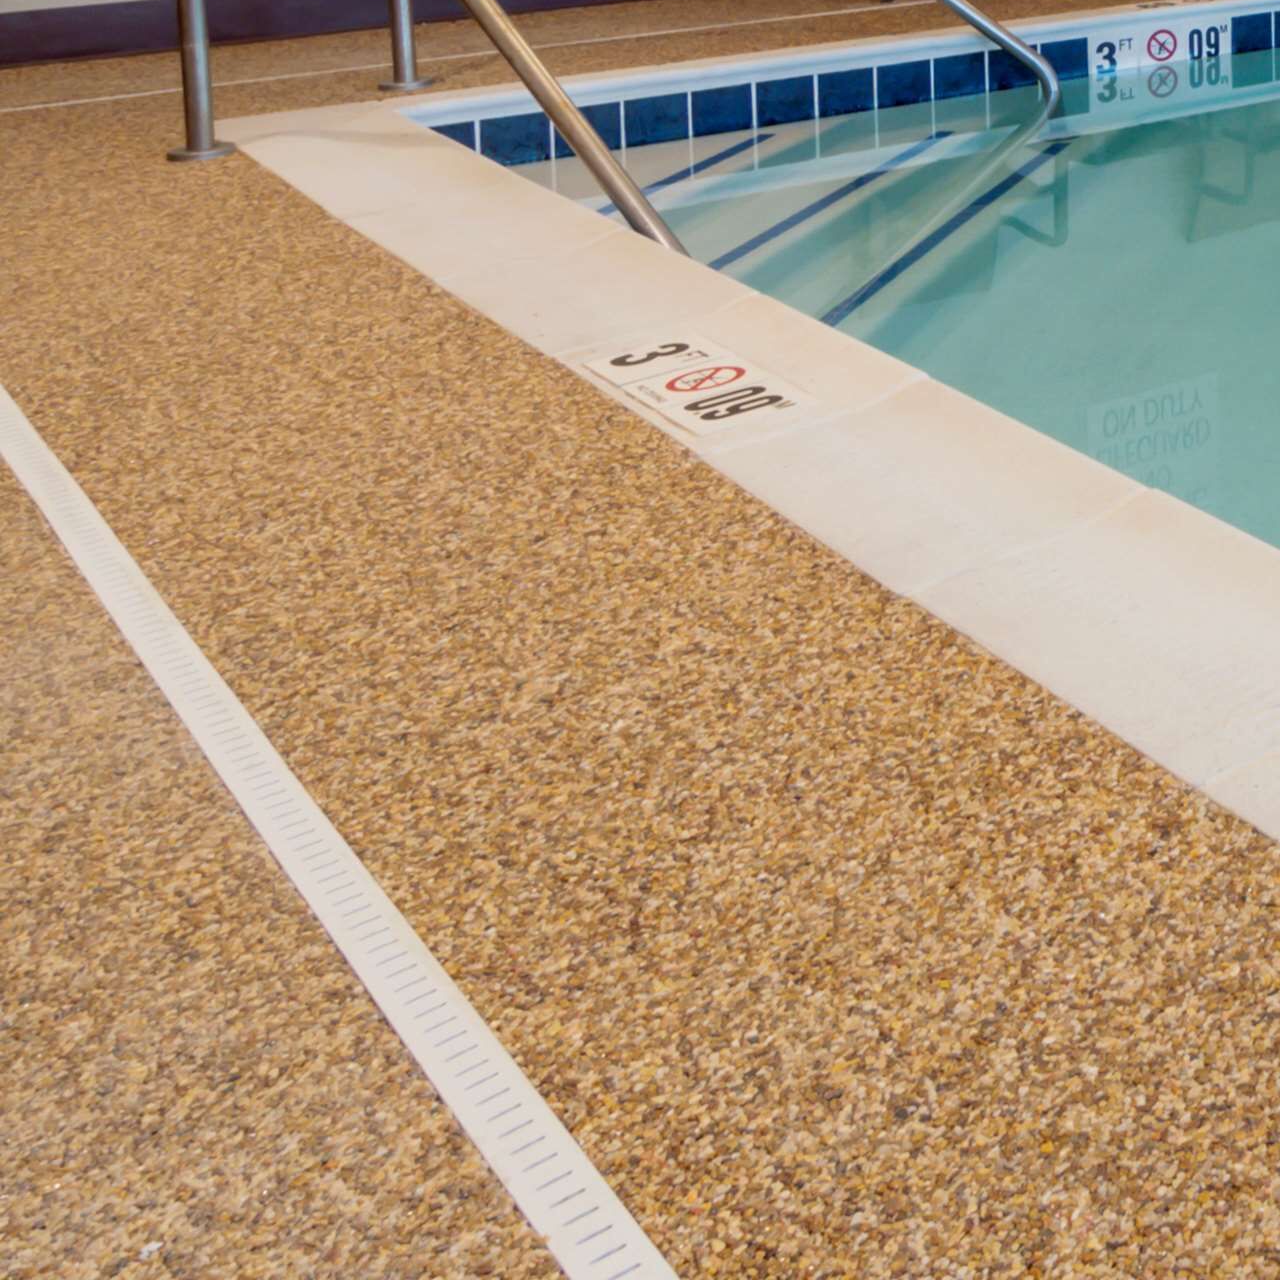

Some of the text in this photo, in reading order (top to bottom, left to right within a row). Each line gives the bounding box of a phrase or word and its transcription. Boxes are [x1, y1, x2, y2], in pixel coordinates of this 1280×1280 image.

[1096, 41, 1117, 73] 3
[1119, 38, 1133, 51] FT
[1189, 26, 1220, 60] 09
[610, 342, 690, 367] 3
